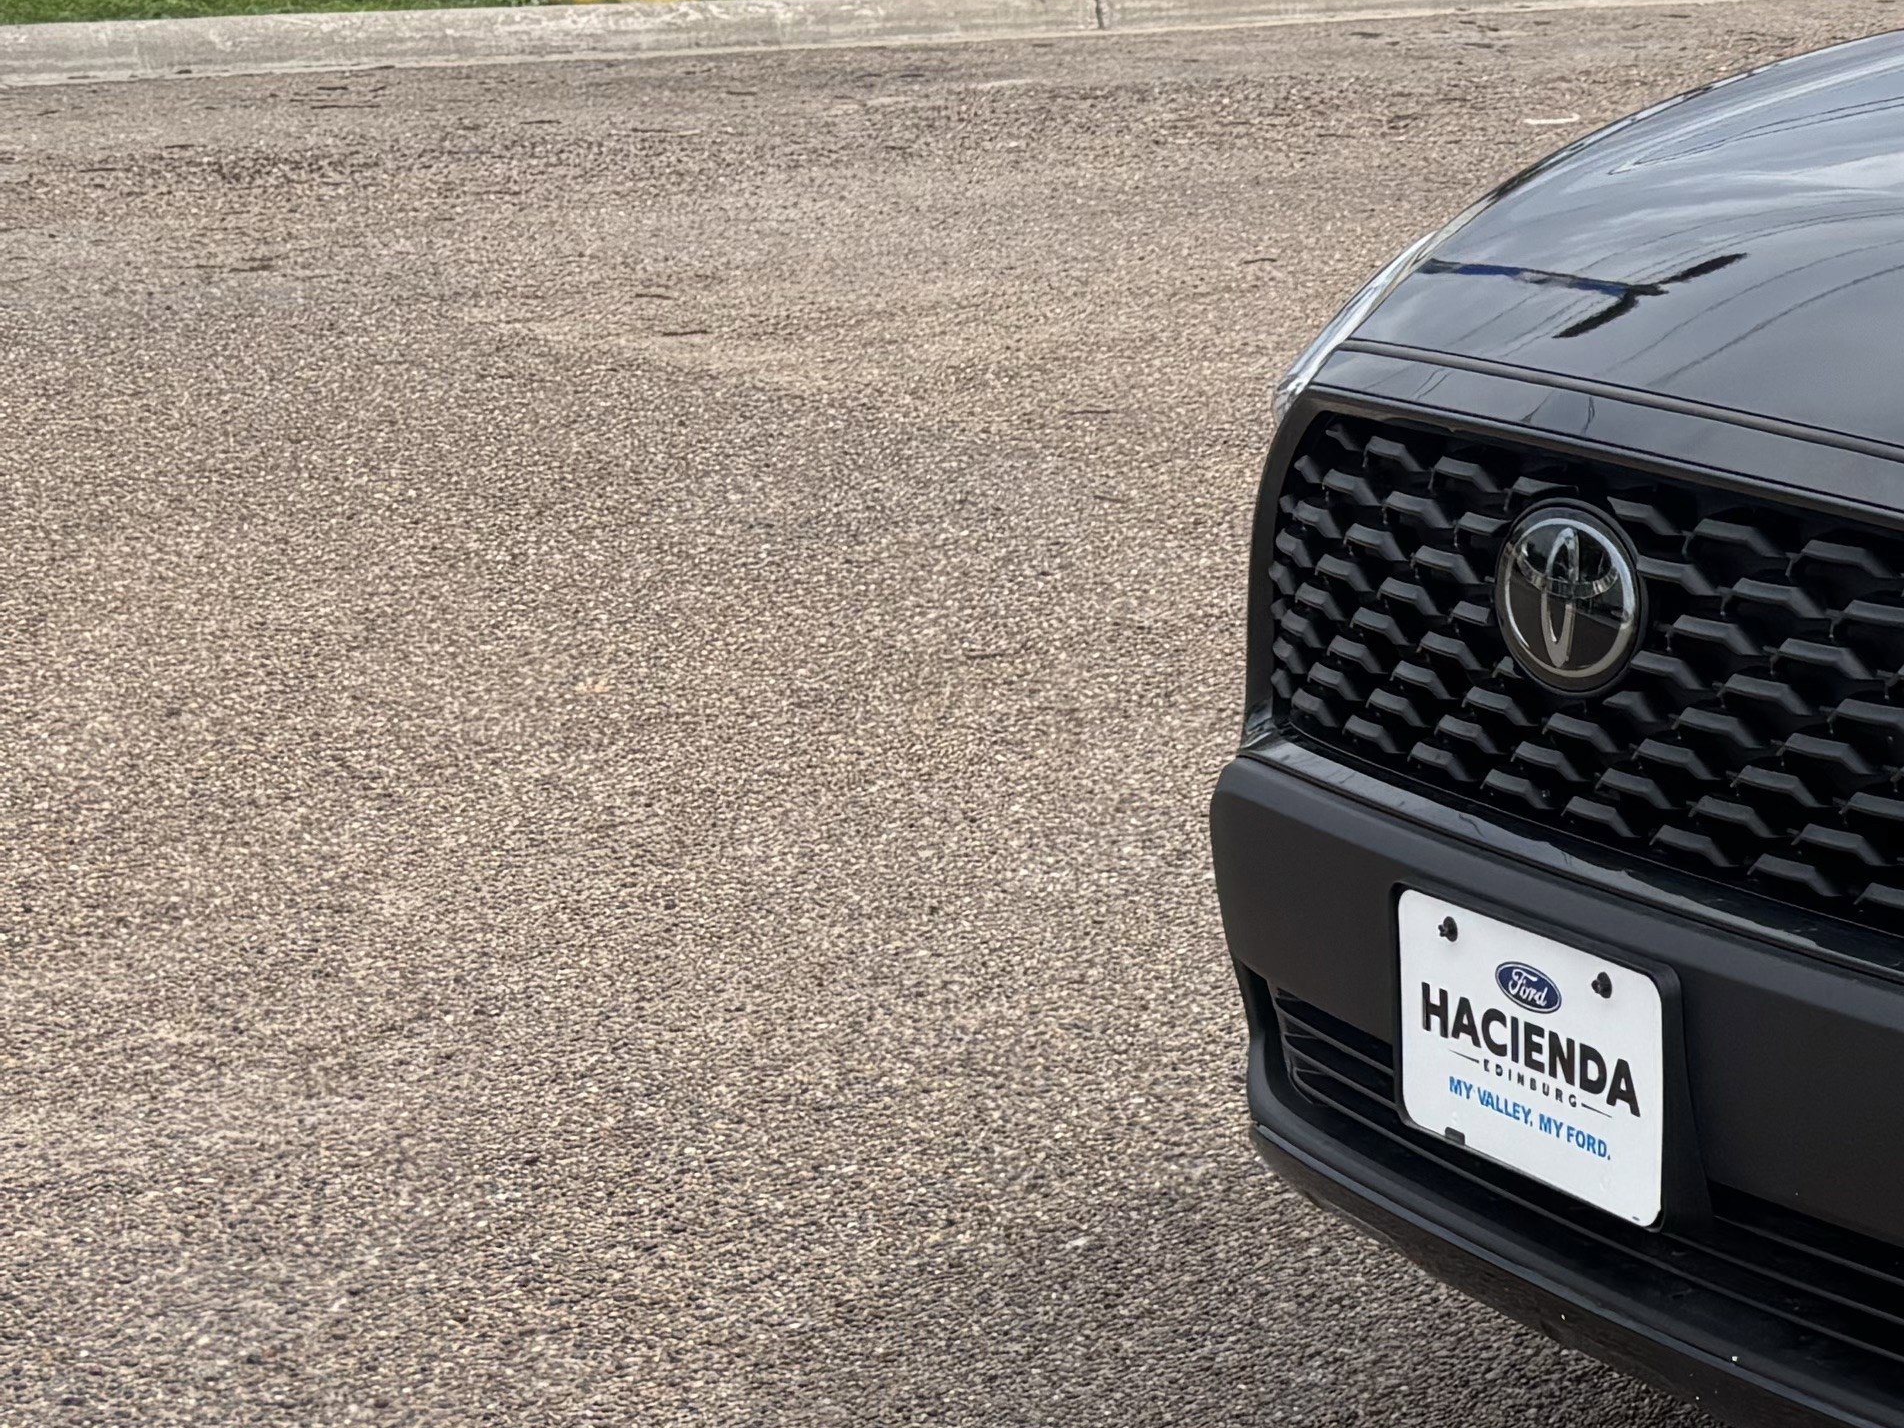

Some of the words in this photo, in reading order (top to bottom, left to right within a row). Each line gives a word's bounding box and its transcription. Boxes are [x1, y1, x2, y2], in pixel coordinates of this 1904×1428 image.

[1507, 968, 1549, 1008] Ford
[1421, 981, 1641, 1118] HACIENDA
[1483, 1059, 1578, 1109] EDINBURG
[1449, 1076, 1475, 1102] MY
[1539, 1113, 1564, 1139] MY
[1566, 1124, 1611, 1161] FORD.
